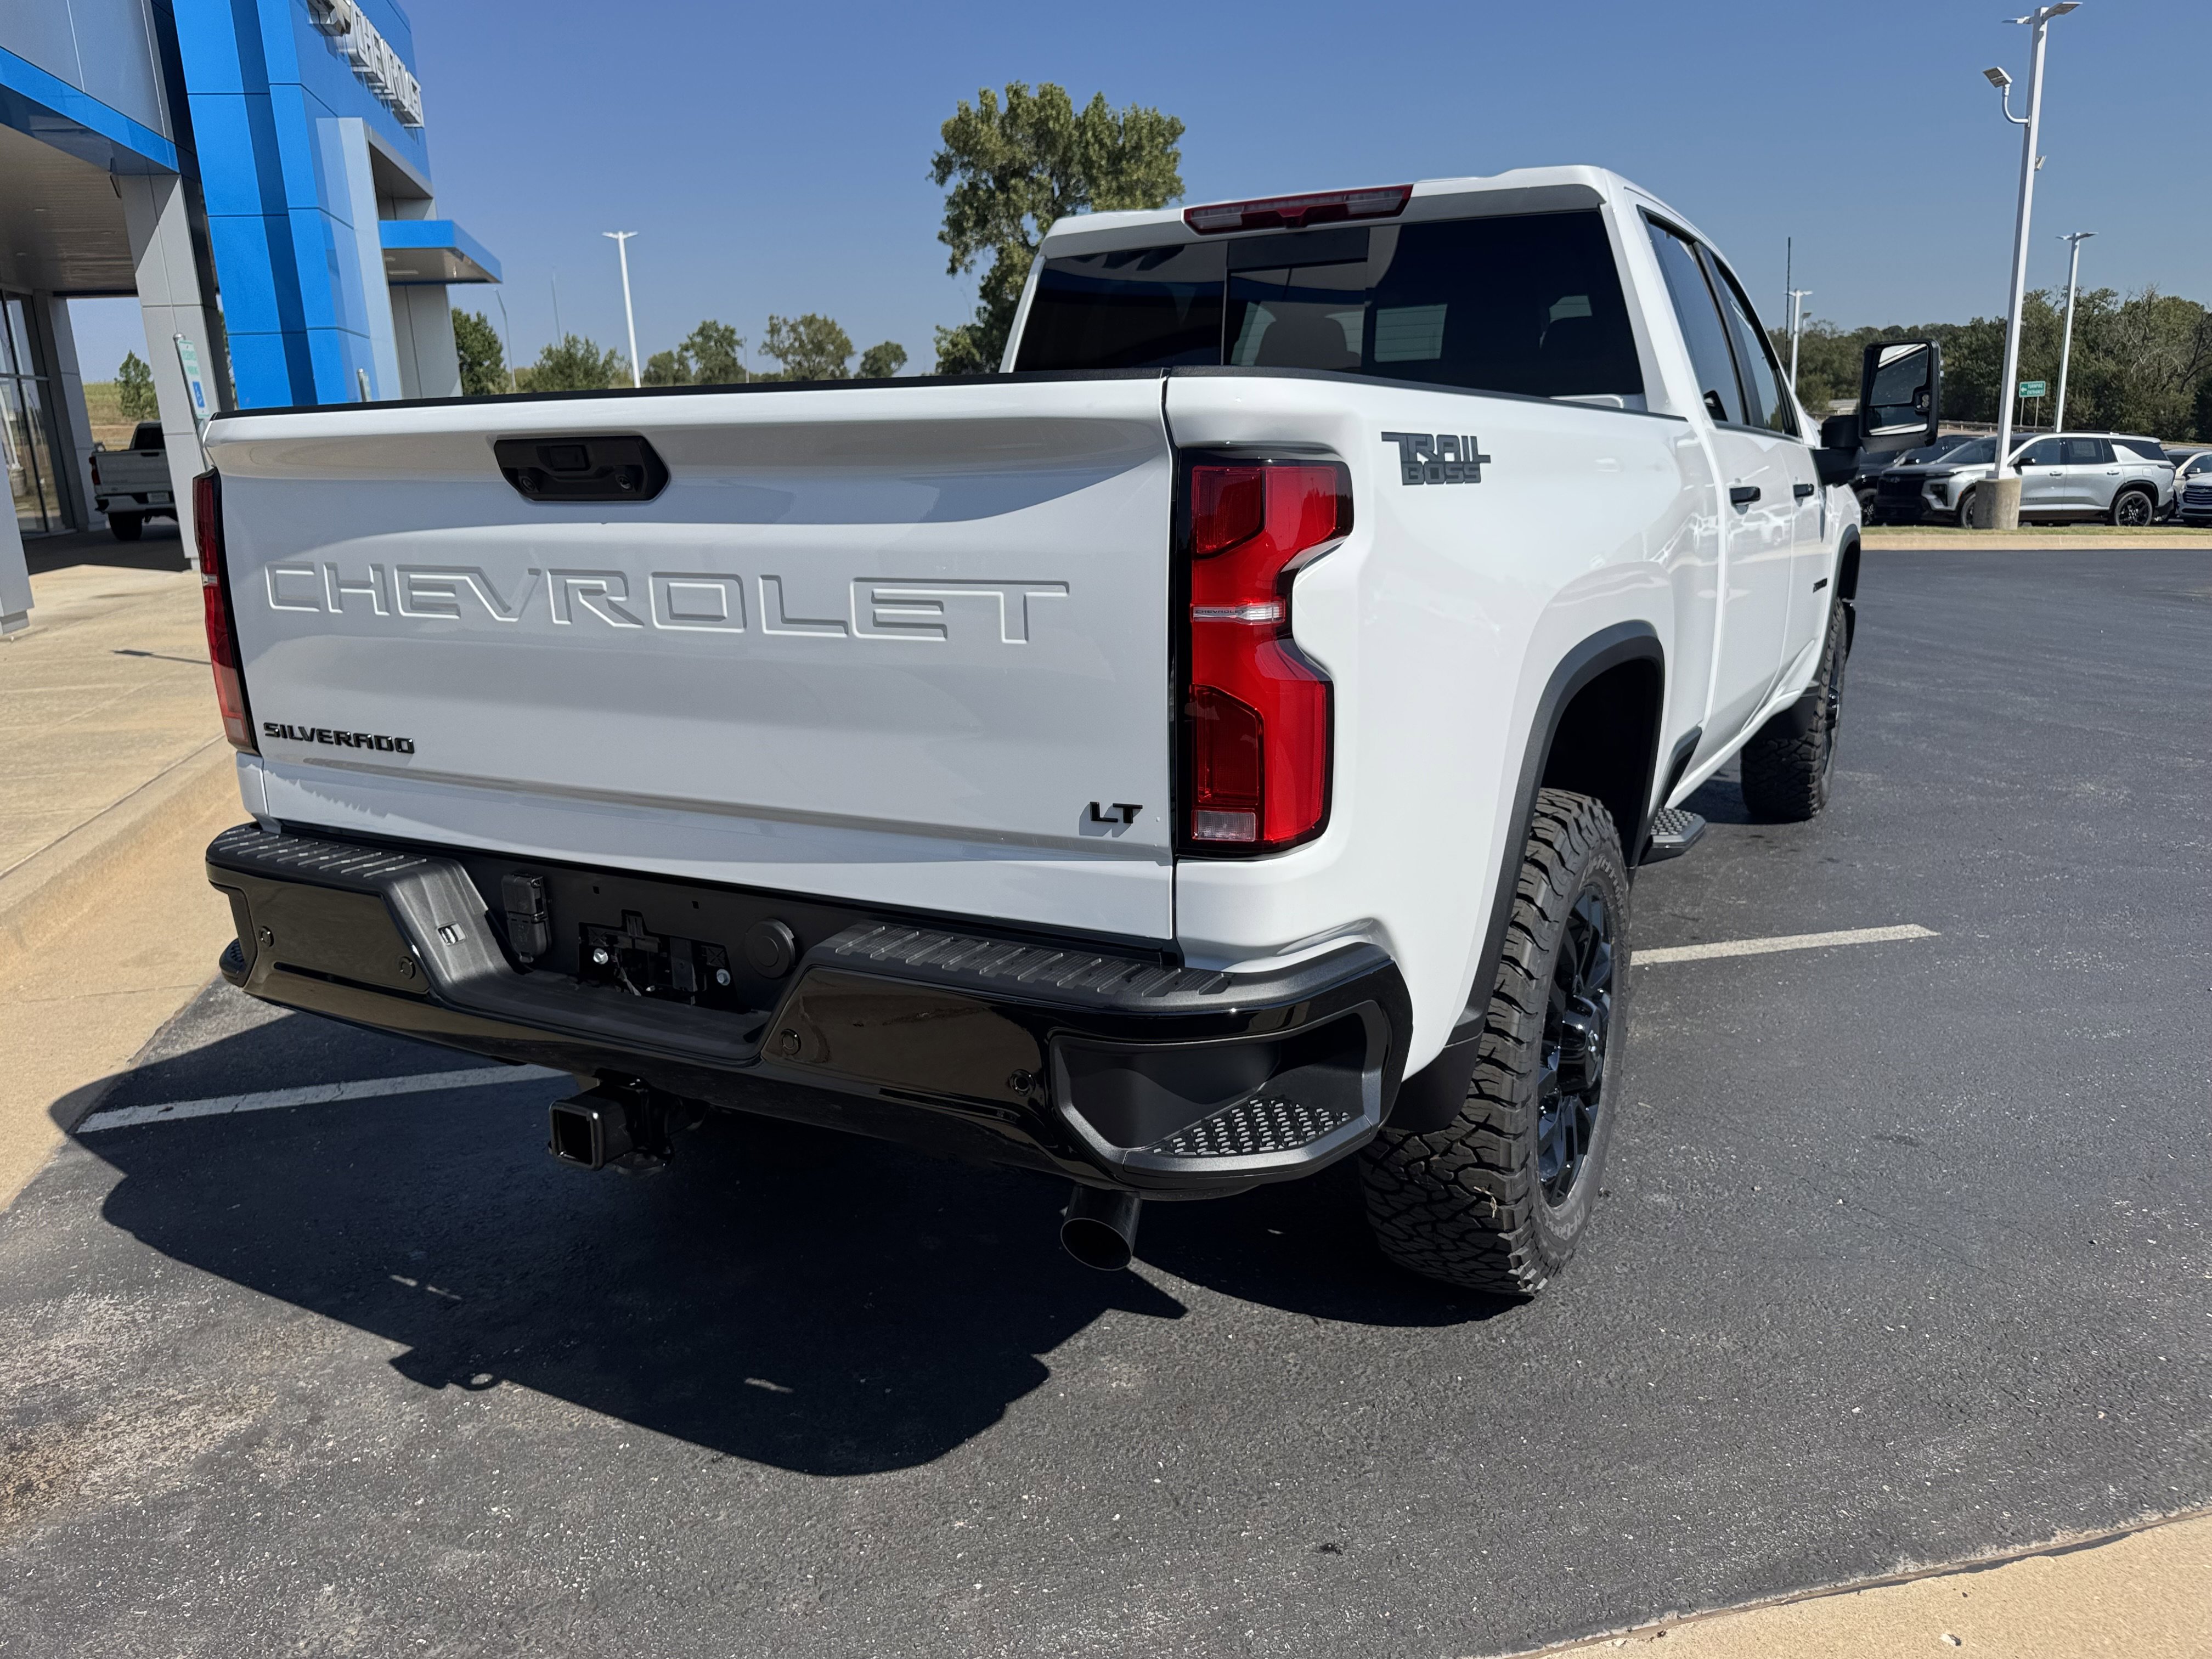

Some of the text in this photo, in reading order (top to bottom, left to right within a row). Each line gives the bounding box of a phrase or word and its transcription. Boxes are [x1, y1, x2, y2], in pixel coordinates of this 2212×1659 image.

[1381, 431, 1491, 464] TRAIL
[1401, 461, 1481, 486] BOSS
[266, 562, 1070, 644] CHEVROLET
[263, 722, 415, 754] SILVERADO
[1090, 802, 1143, 823] LT
